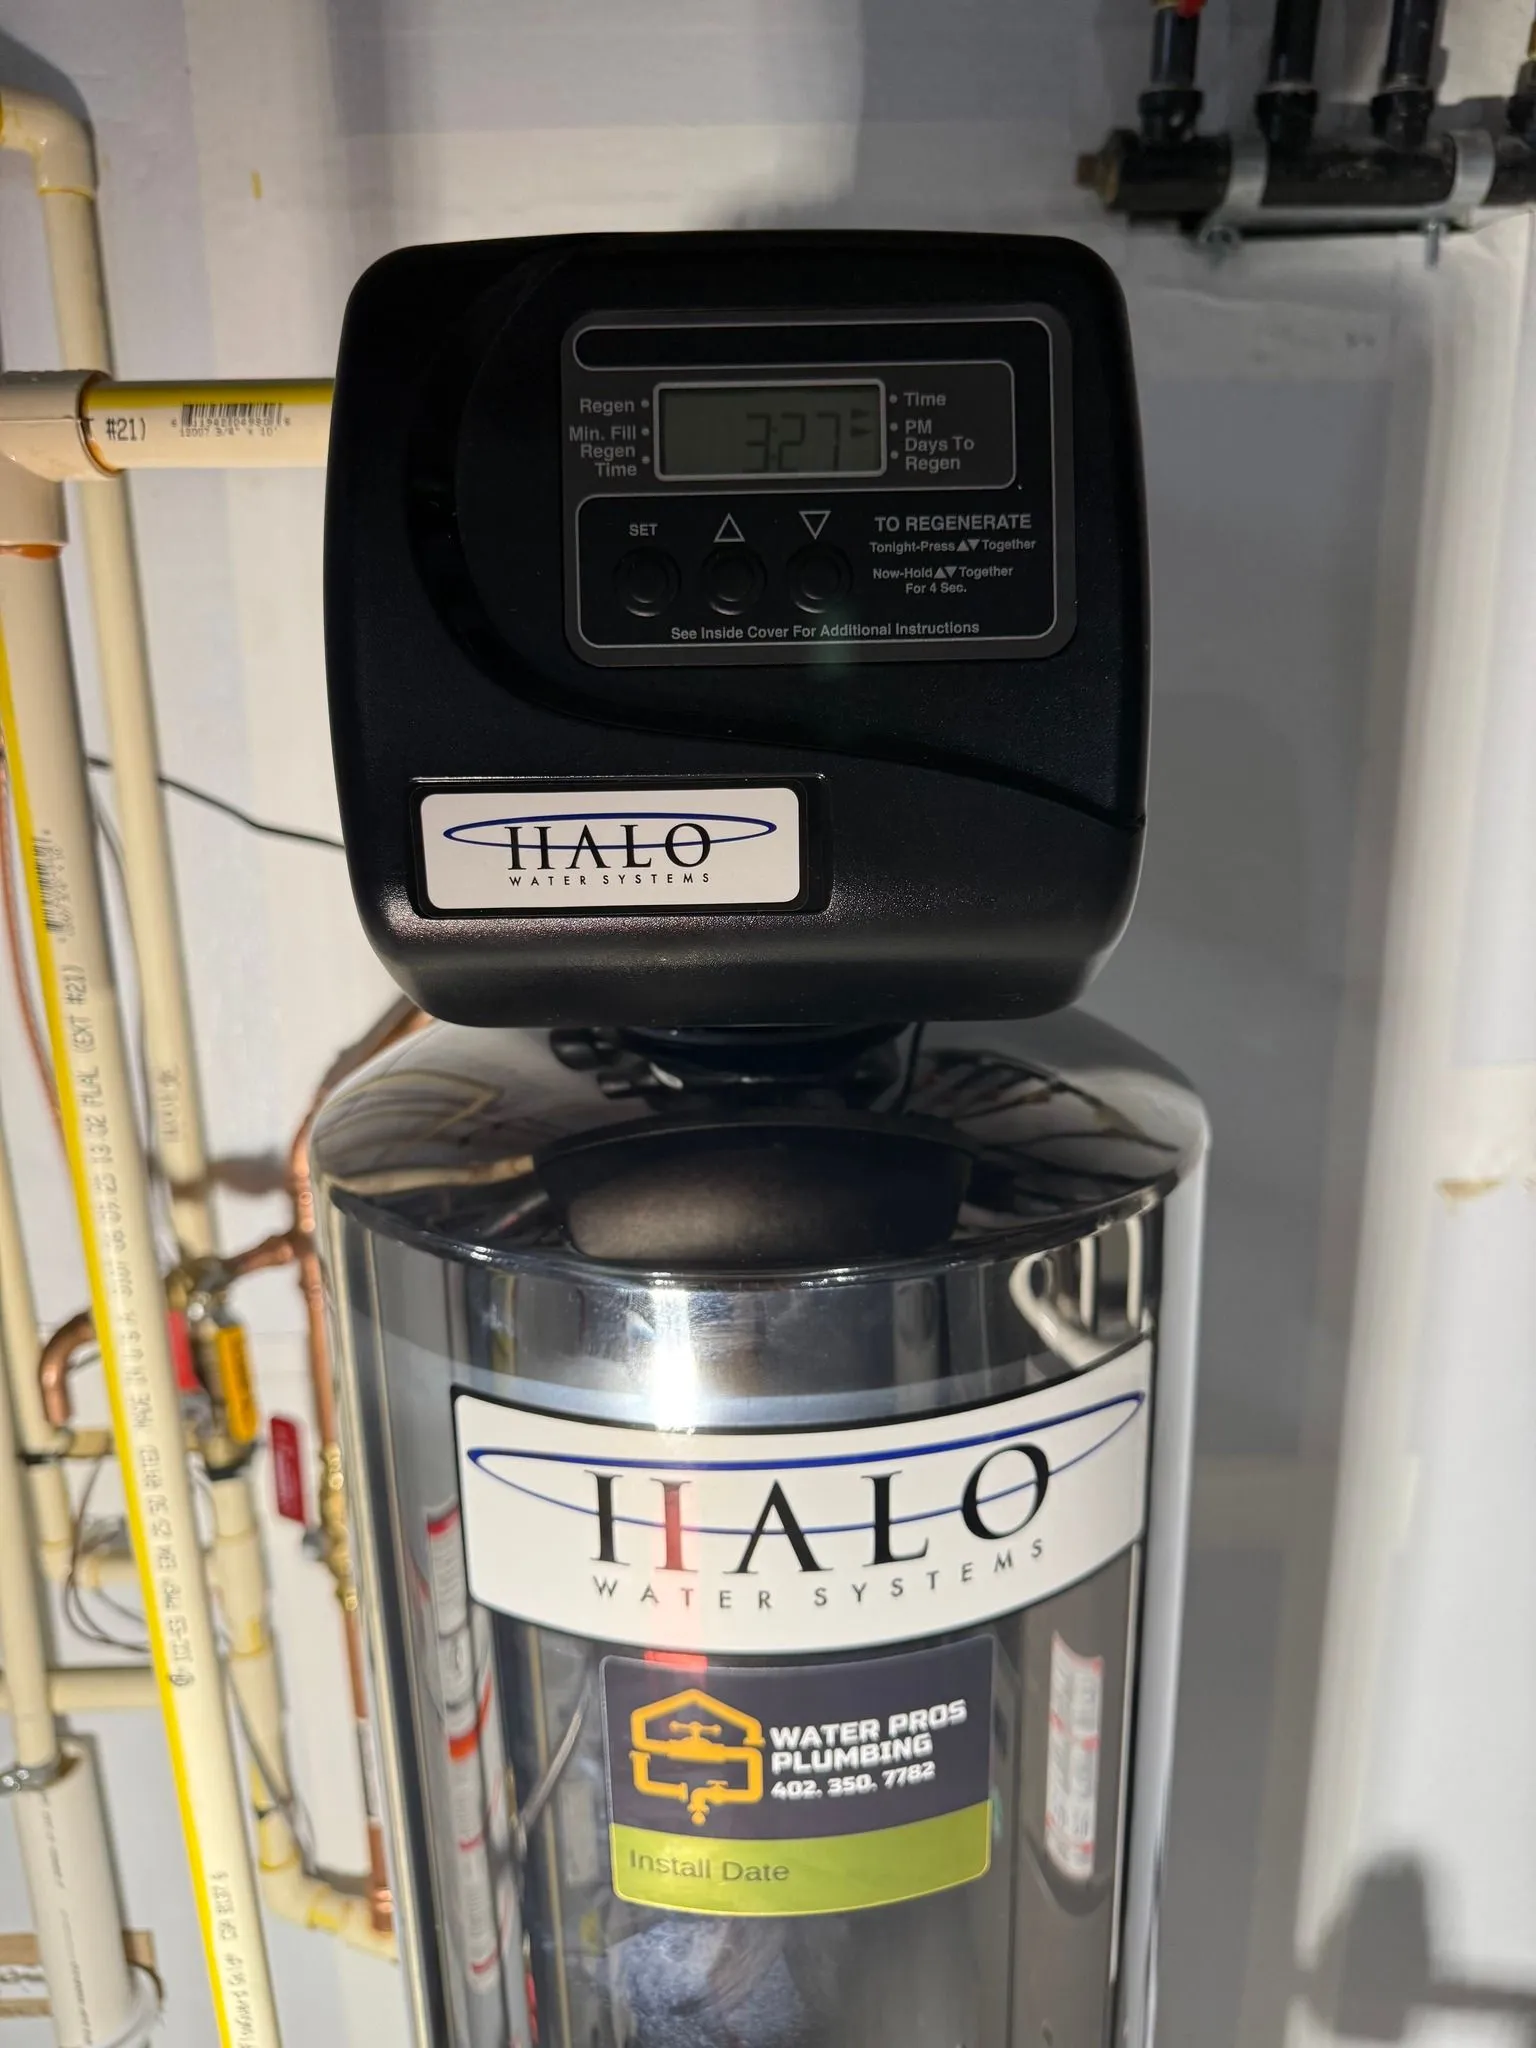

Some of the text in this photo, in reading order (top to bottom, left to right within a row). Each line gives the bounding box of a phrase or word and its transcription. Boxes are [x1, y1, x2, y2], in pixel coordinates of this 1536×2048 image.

[580, 398, 635, 416] Regen
[904, 392, 946, 406] Time
[106, 417, 146, 441] #21)
[569, 424, 637, 442] Min. Fill
[905, 419, 932, 434] PM
[580, 443, 636, 461] Regen
[743, 412, 843, 474] 3:27
[904, 436, 975, 455] Days To
[594, 461, 638, 477] Time
[905, 455, 961, 473] Regen
[629, 524, 658, 537] SET
[875, 514, 1032, 532] TO REGENERATE
[869, 538, 1037, 555] Tonight-Press Together
[873, 565, 1014, 580] Now-Hold Together
[905, 581, 967, 594] For 4 Sec.
[671, 621, 981, 640] See Inside Cover For Additional Instructions
[504, 822, 712, 871] HALO
[509, 872, 711, 887] WATER SYSTEMS
[583, 1442, 1051, 1575] HALO
[592, 1537, 1045, 1611] WATER SYSTEMS
[770, 1698, 967, 1751] WATER PROS
[771, 1732, 934, 1776] PLUMBING
[770, 1761, 937, 1801] 402. 350. 7782
[629, 1848, 790, 1883] Install Date
